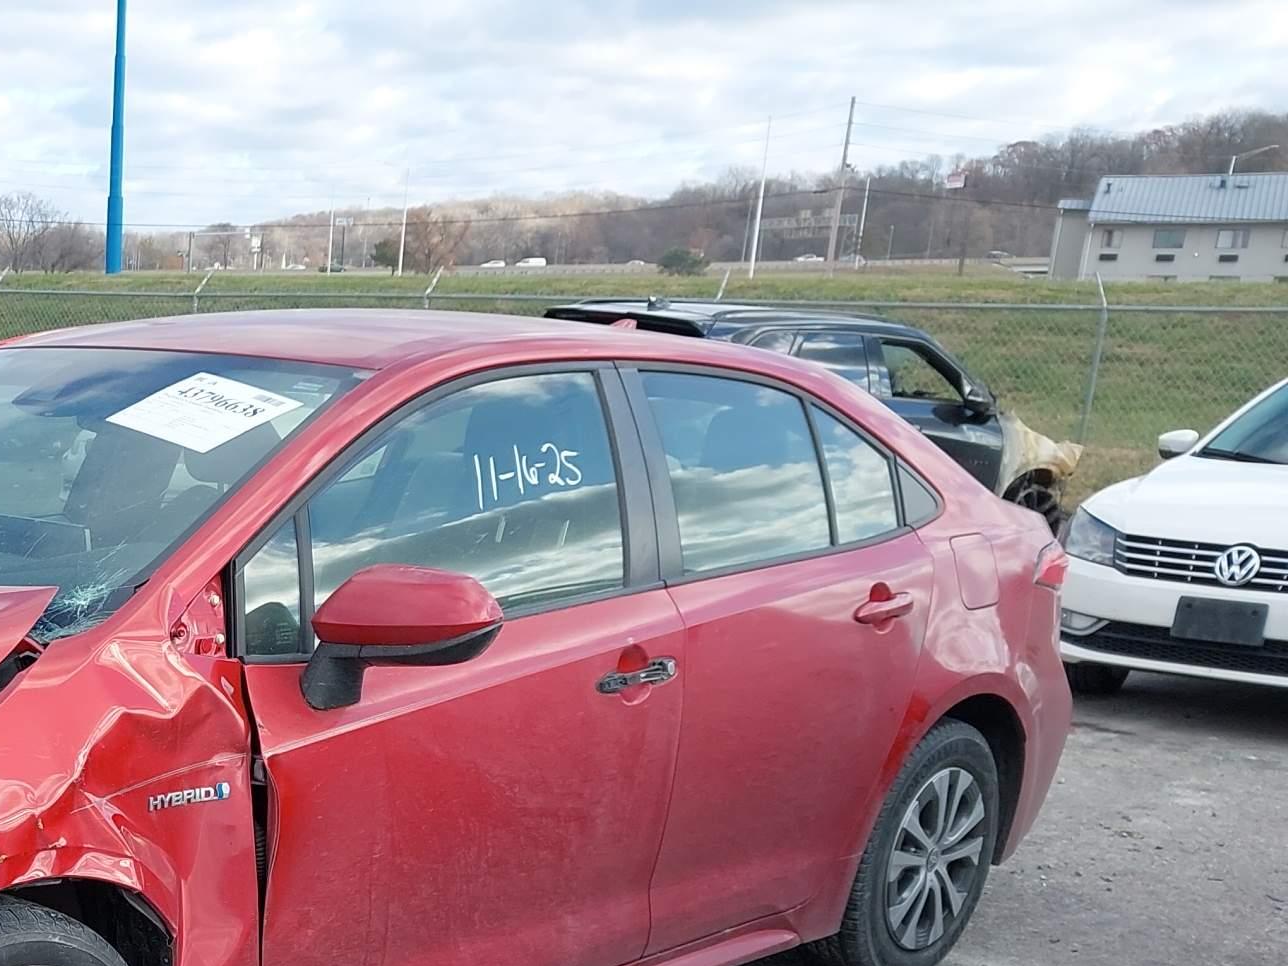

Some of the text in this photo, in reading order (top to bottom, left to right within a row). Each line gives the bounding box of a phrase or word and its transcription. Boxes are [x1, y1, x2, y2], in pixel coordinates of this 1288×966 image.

[177, 386, 266, 418] 43796638
[474, 442, 582, 511] 11-16-25
[148, 786, 215, 812] HYBRID
